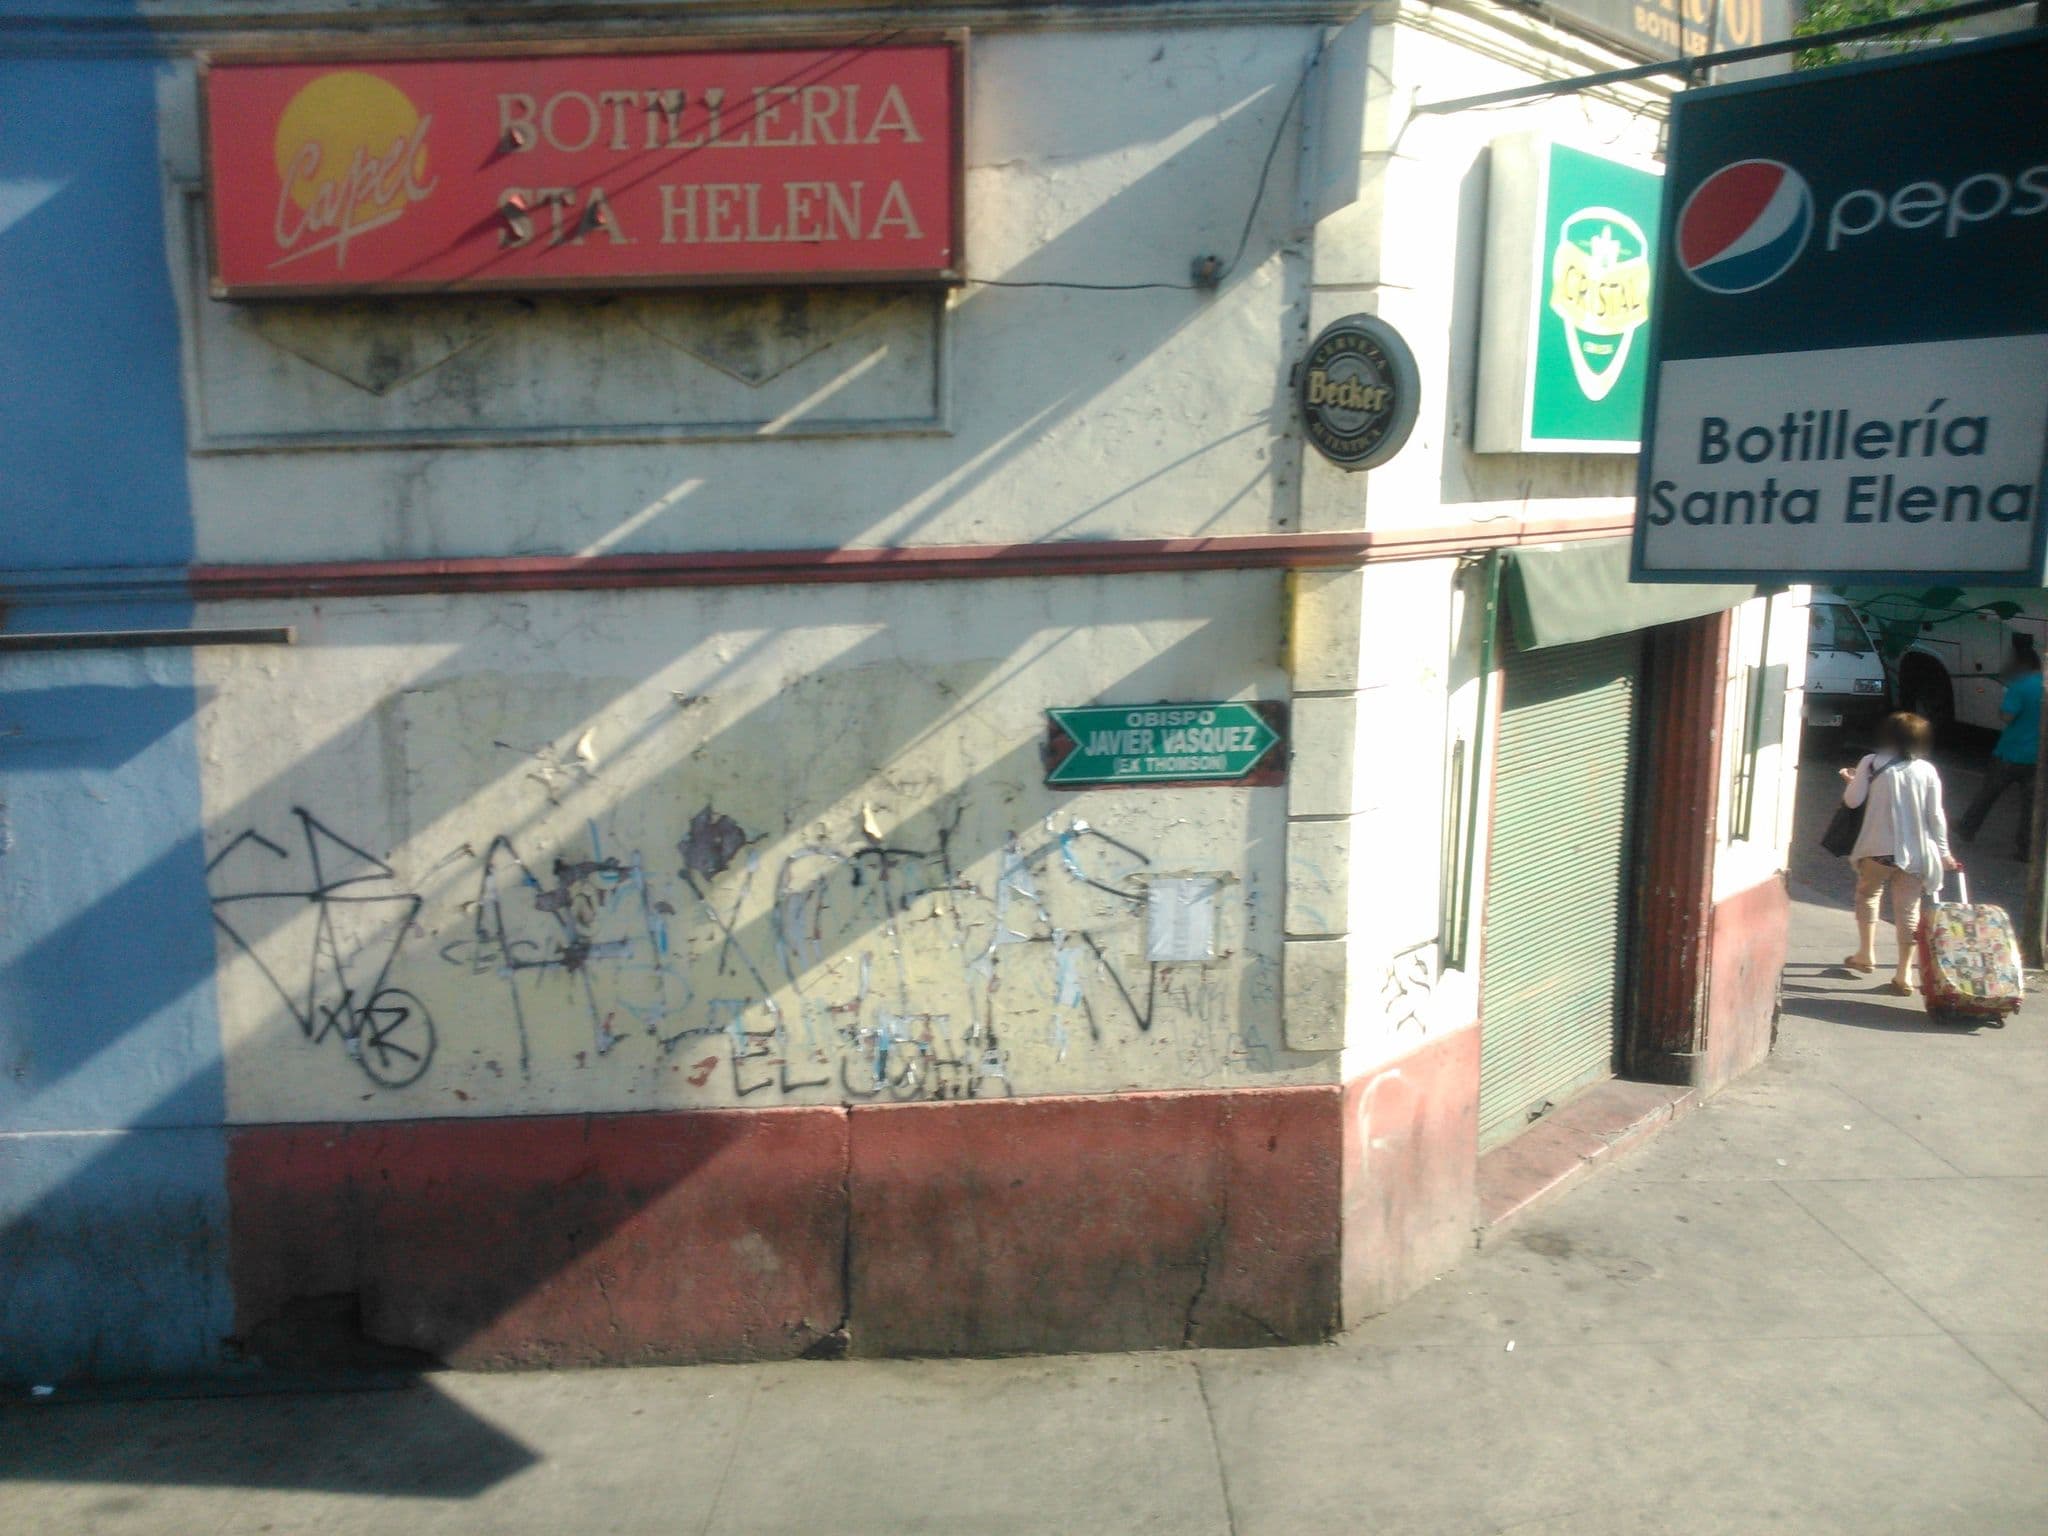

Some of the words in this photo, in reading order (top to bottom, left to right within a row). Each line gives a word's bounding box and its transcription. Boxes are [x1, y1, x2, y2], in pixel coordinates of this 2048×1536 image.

[496, 83, 924, 153] BOTILLERIA
[658, 179, 925, 243] HELENA
[1827, 165, 2048, 251] peps
[1306, 368, 1388, 411] Becker
[1697, 397, 1989, 465] Botillería
[1648, 477, 1820, 526] Santa
[1844, 473, 2034, 524] Elena
[1085, 728, 1155, 756] JAVIER
[1160, 726, 1257, 754] VASQUEZ
[1126, 710, 1217, 727] OBISPO
